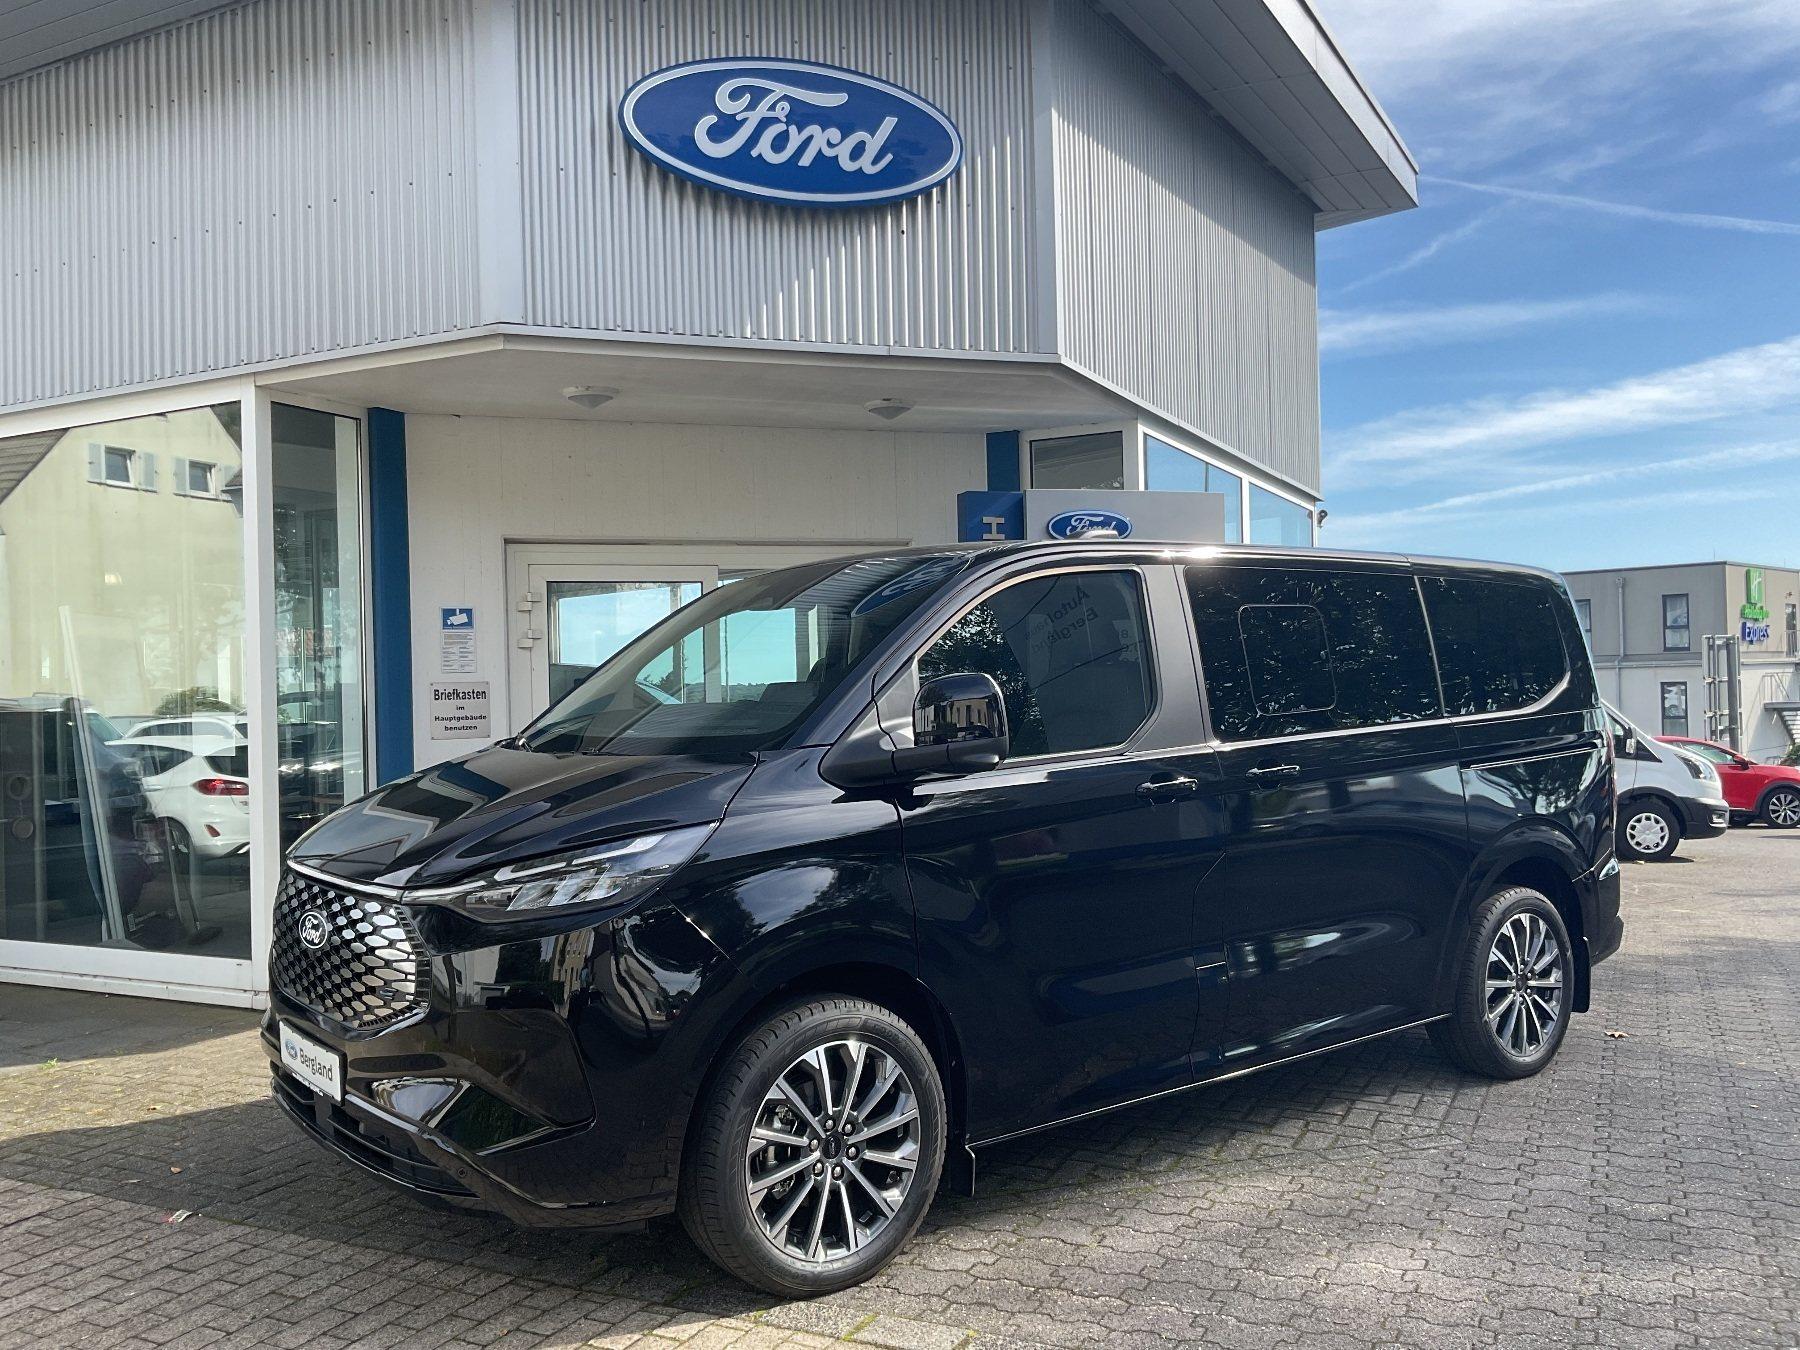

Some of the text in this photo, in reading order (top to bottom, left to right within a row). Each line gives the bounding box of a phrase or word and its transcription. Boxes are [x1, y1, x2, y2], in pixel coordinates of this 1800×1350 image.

[694, 77, 898, 175] Ford
[433, 688, 487, 701] Briefkasten
[434, 714, 488, 723] Hauptgebäude
[302, 915, 323, 944] Ford
[299, 1047, 333, 1082] Bergland
